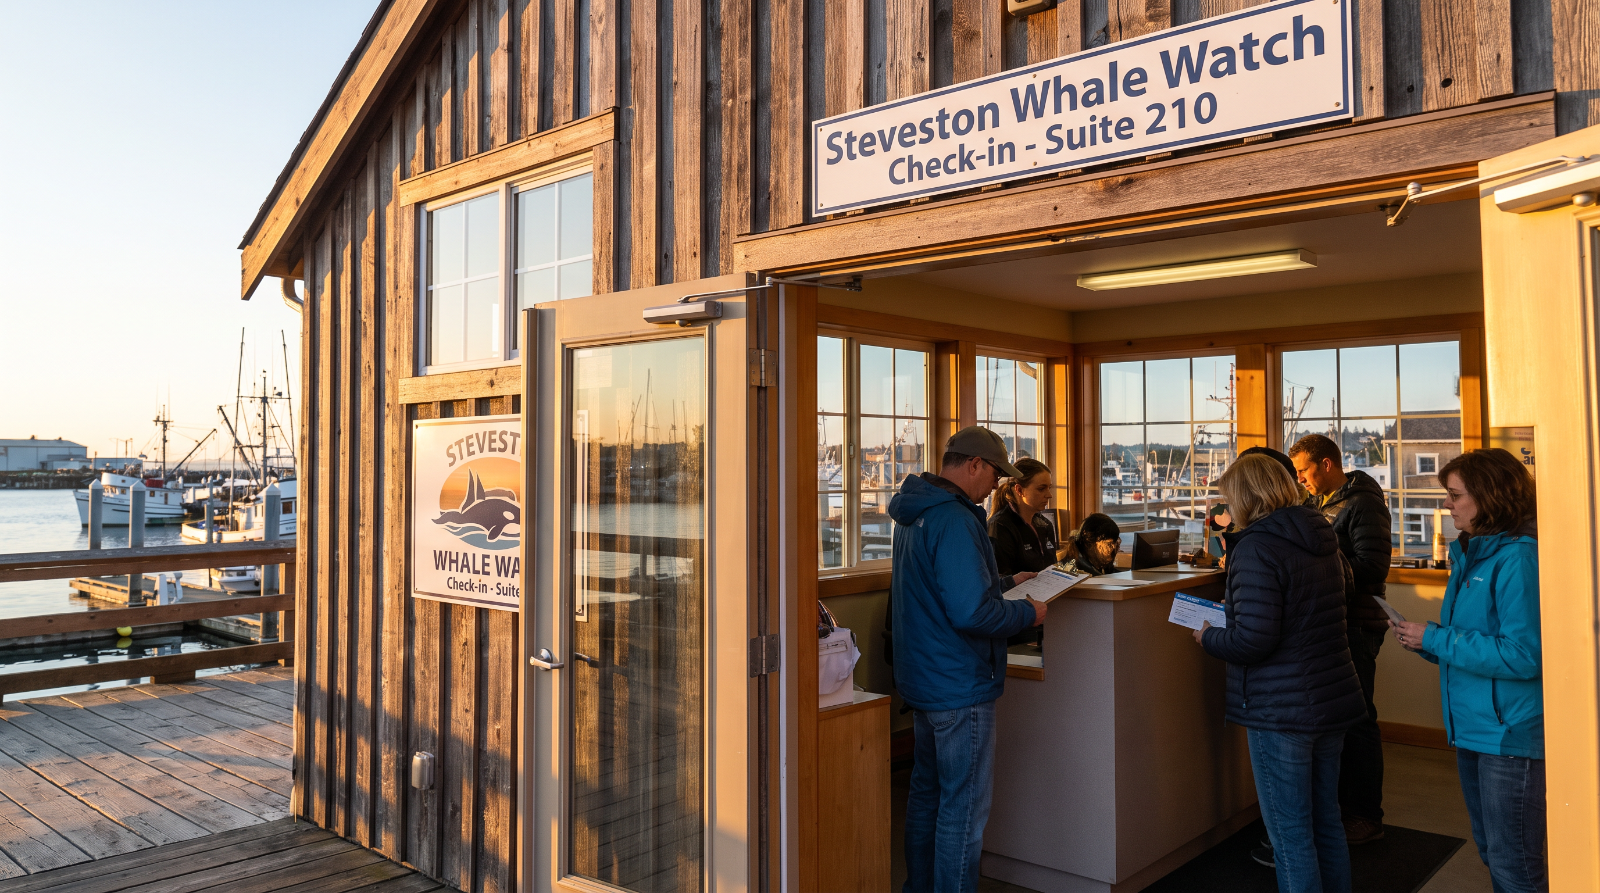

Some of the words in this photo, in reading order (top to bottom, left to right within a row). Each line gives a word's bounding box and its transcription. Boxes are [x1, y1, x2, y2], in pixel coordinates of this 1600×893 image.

[826, 102, 1000, 165] Steveston
[1010, 60, 1148, 123] Whale
[1159, 16, 1325, 89] Watch
[888, 138, 1016, 186] Check-in
[1045, 115, 1135, 155] Suite
[1145, 92, 1218, 136] 210
[446, 430, 521, 468] STEVEST
[433, 549, 490, 576] WHALE
[446, 576, 488, 594] Check-in
[496, 582, 520, 598] Suite
